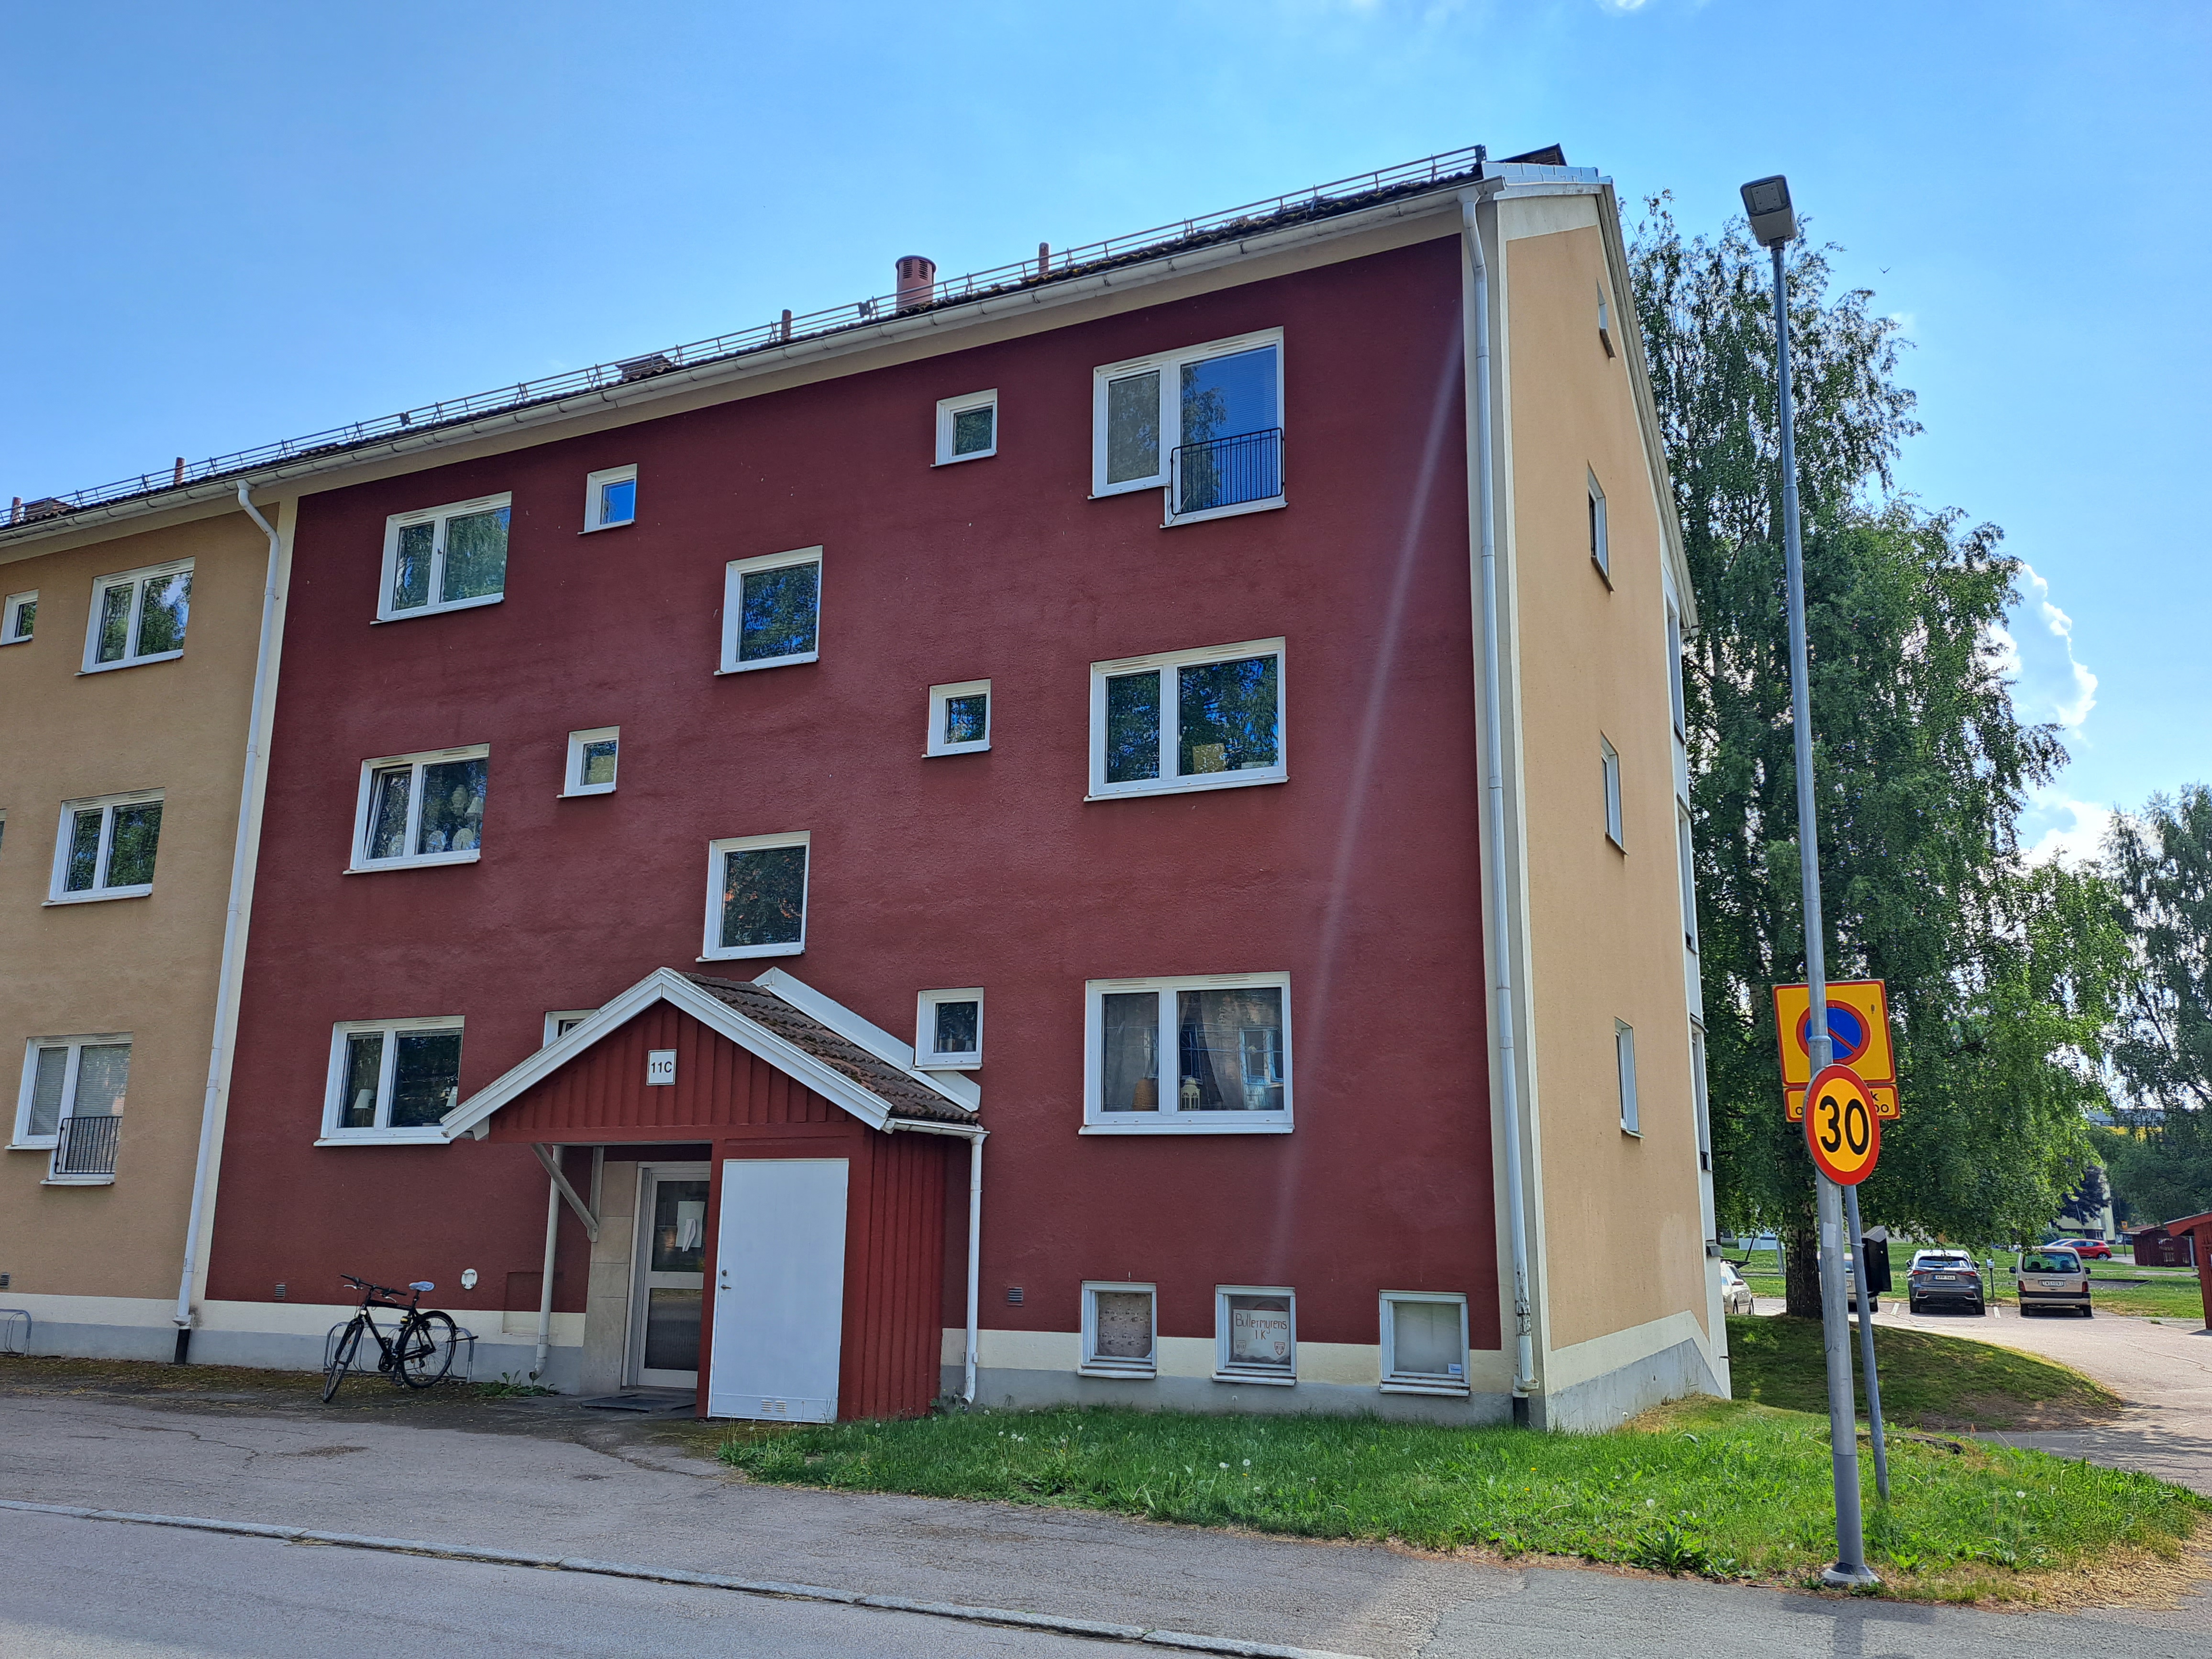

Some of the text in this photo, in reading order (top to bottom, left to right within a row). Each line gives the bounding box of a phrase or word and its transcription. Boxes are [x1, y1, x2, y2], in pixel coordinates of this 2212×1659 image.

[651, 1062, 672, 1073] 11C
[1819, 1095, 1869, 1155] 30
[1235, 1313, 1287, 1334] Bullermyrens
